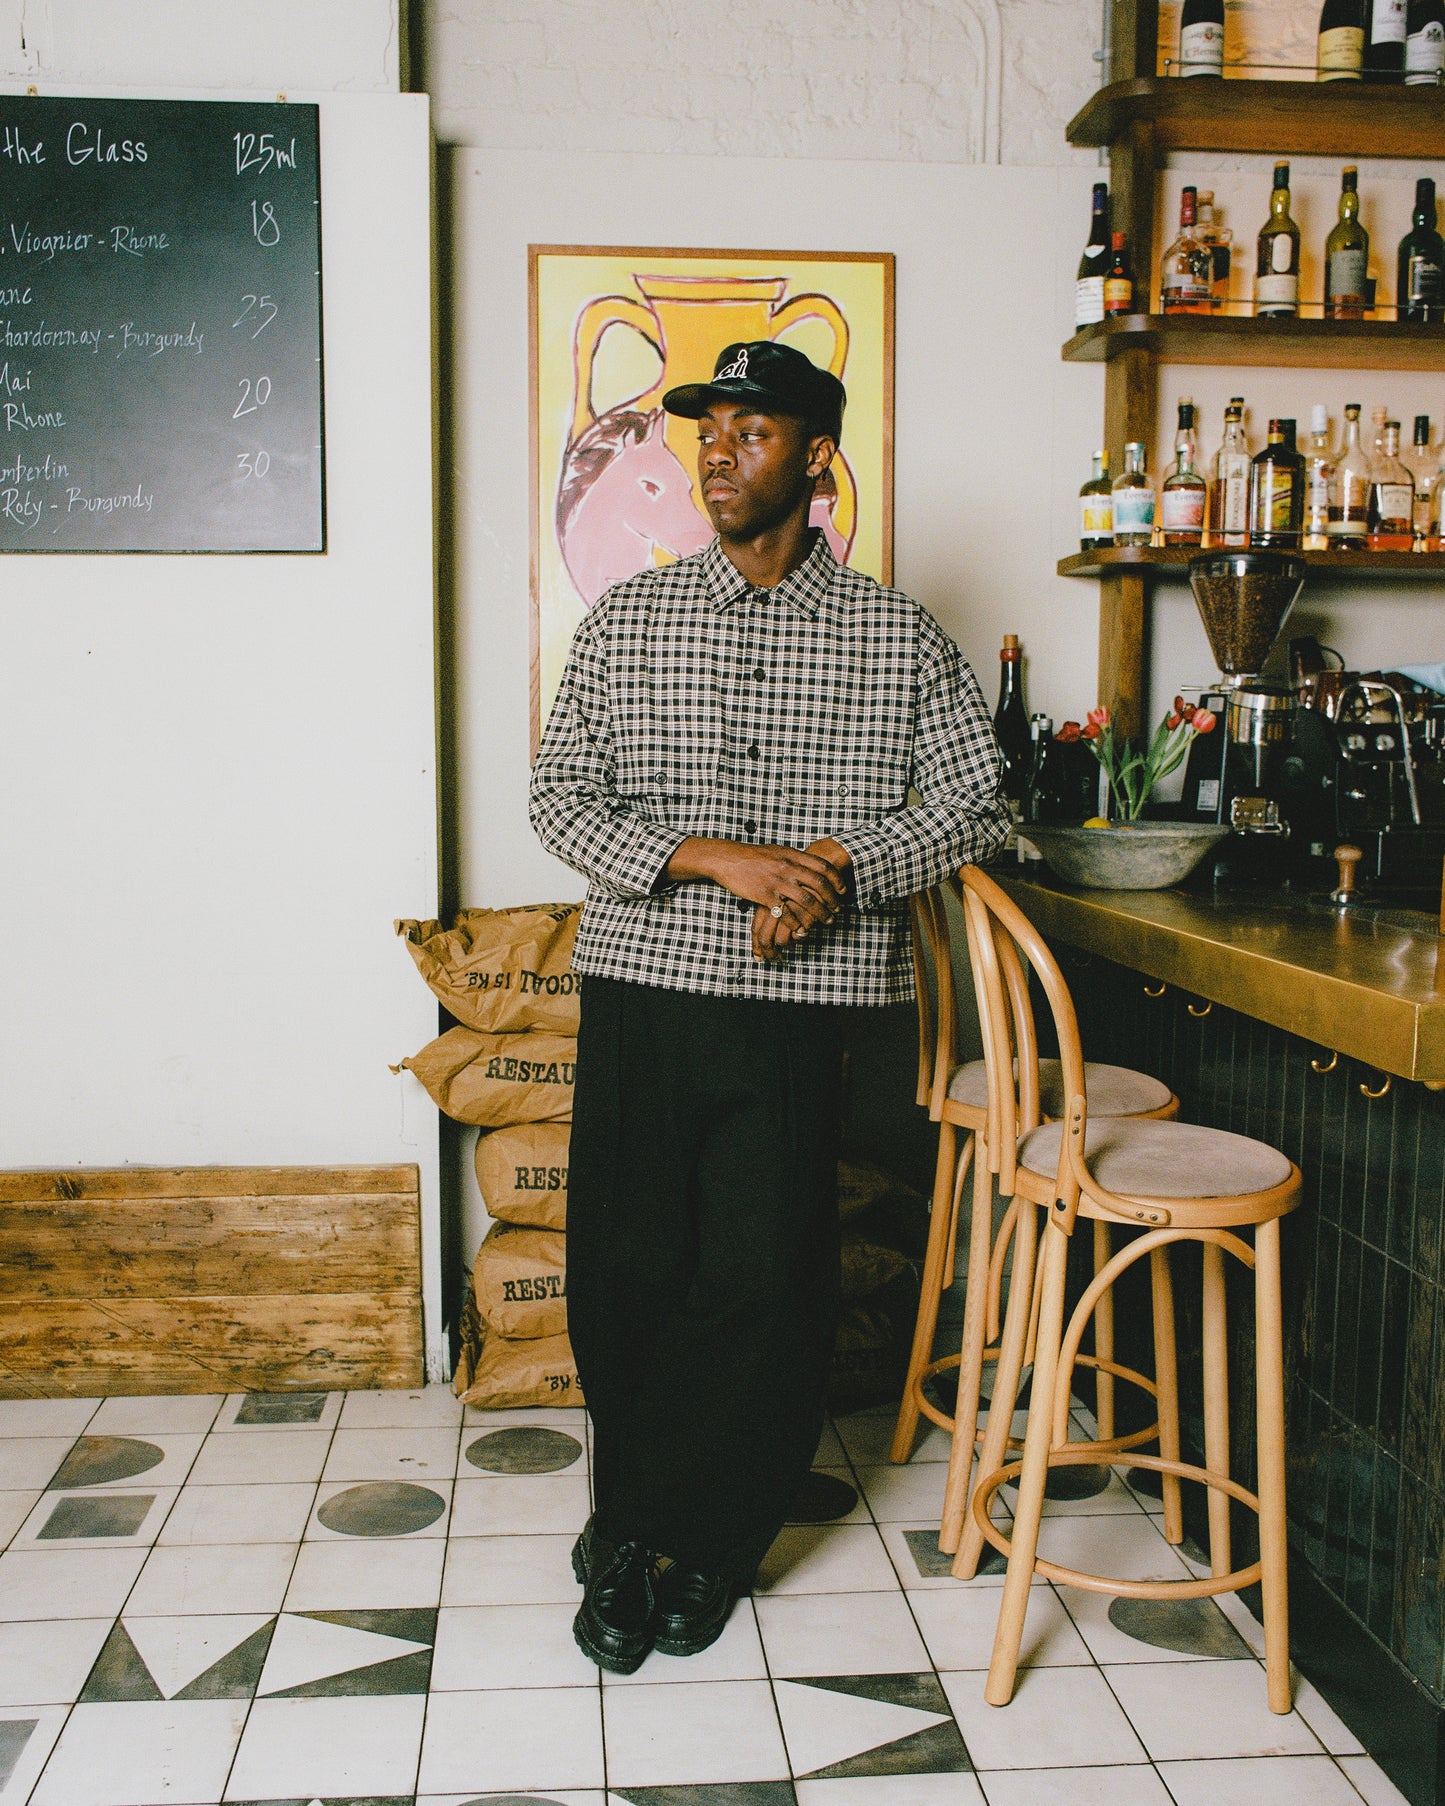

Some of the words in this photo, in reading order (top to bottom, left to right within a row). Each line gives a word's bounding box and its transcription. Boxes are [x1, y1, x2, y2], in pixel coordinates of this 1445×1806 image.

[2, 126, 46, 165] the
[66, 122, 149, 166] Glass
[233, 132, 297, 176] 125ml
[110, 225, 170, 258] Rhone
[251, 200, 281, 247] 18
[232, 294, 279, 339] 25
[116, 321, 205, 359] Burgundy
[3, 402, 66, 431] Rhone
[232, 376, 272, 419] 20
[236, 450, 271, 480] 30
[64, 484, 154, 517] Burgundy
